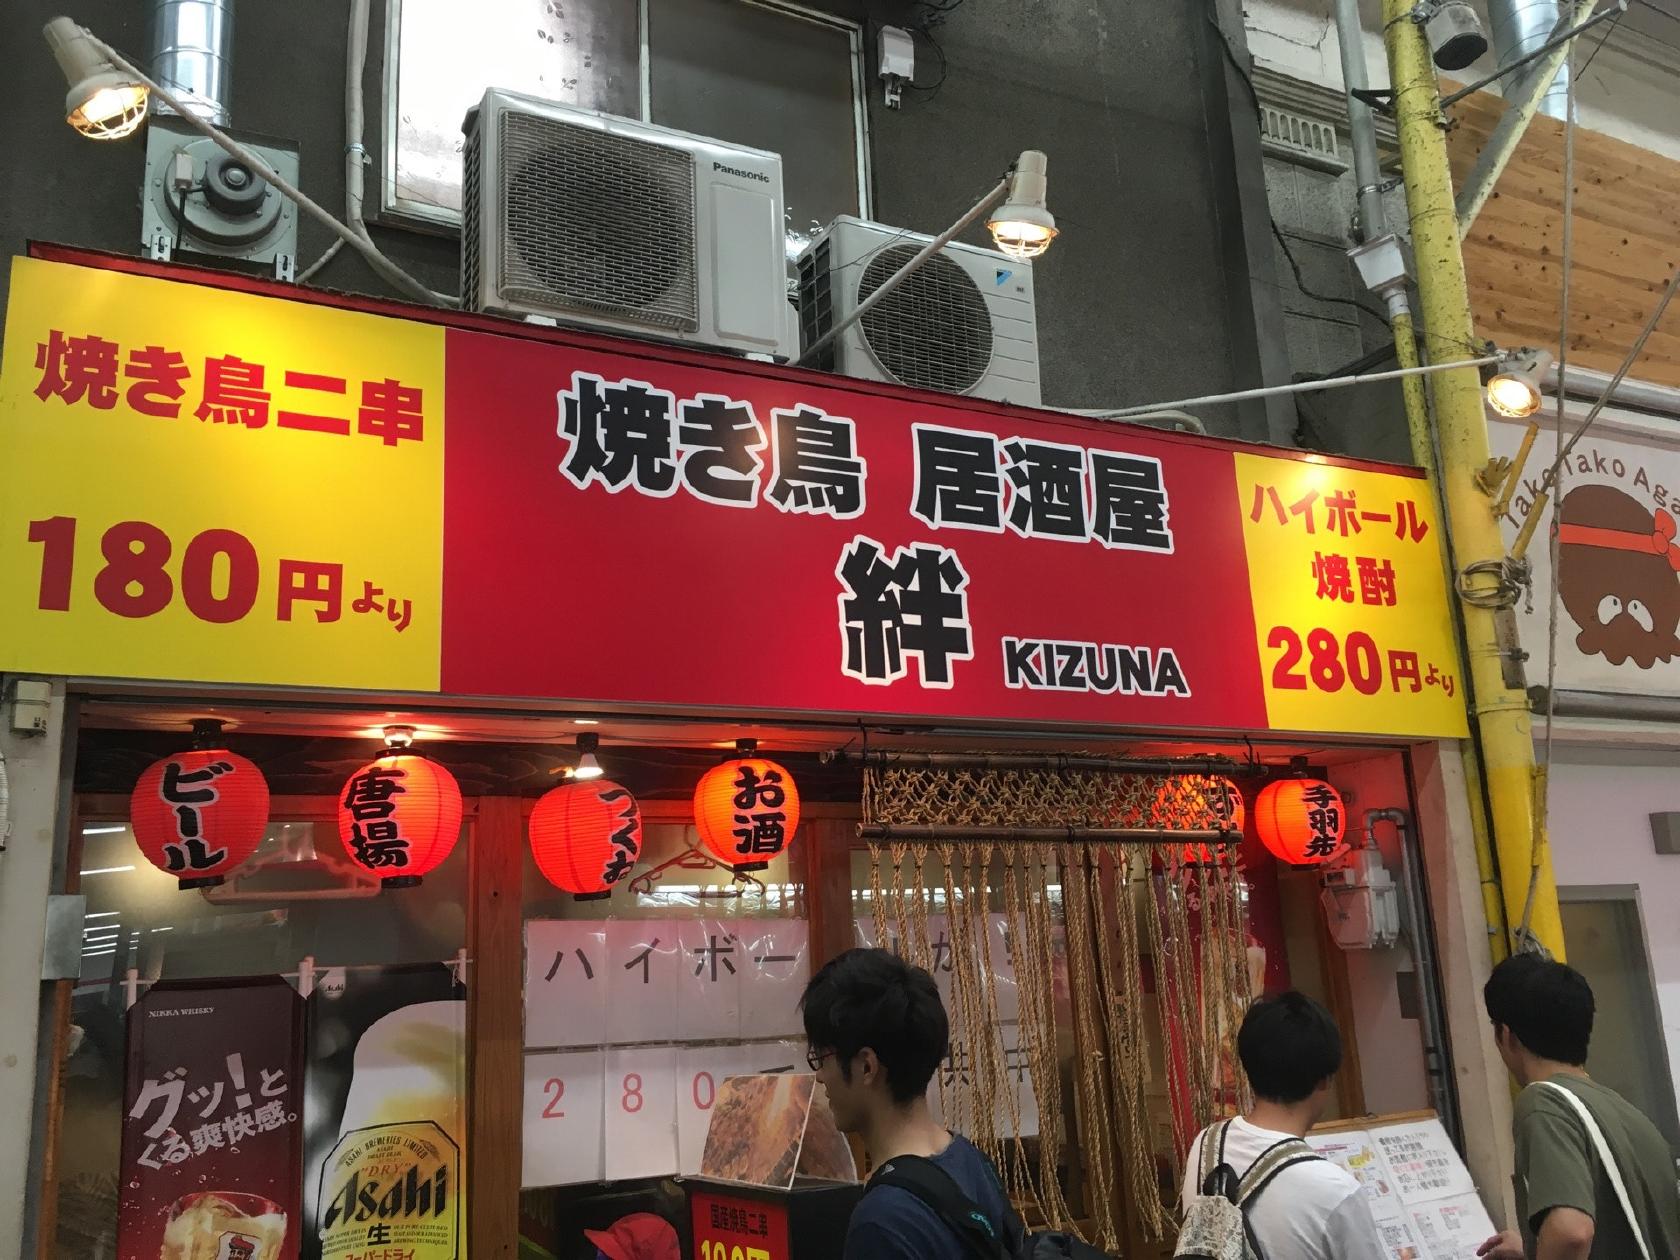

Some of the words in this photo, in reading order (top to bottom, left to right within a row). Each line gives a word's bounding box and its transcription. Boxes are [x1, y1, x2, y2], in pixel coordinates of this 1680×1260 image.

[712, 161, 770, 183] Panasonic
[34, 330, 424, 447] 焼き鳥二串
[557, 370, 867, 520] 焼き鳥
[911, 422, 1174, 554] 居酒屋
[1250, 483, 1429, 543] ハイボール
[835, 534, 974, 689] 絆
[1001, 635, 1192, 697] KIZUNA
[1311, 551, 1397, 607] 焼酎
[163, 762, 235, 871] ビール
[344, 766, 410, 869] 唐揚
[733, 766, 786, 854] お酒
[1302, 784, 1341, 857] 手羽先
[148, 1008, 179, 1018] NIKKA
[180, 1006, 215, 1015] WHISKY
[325, 1164, 448, 1229] Asahi
[367, 1223, 391, 1246] 生
